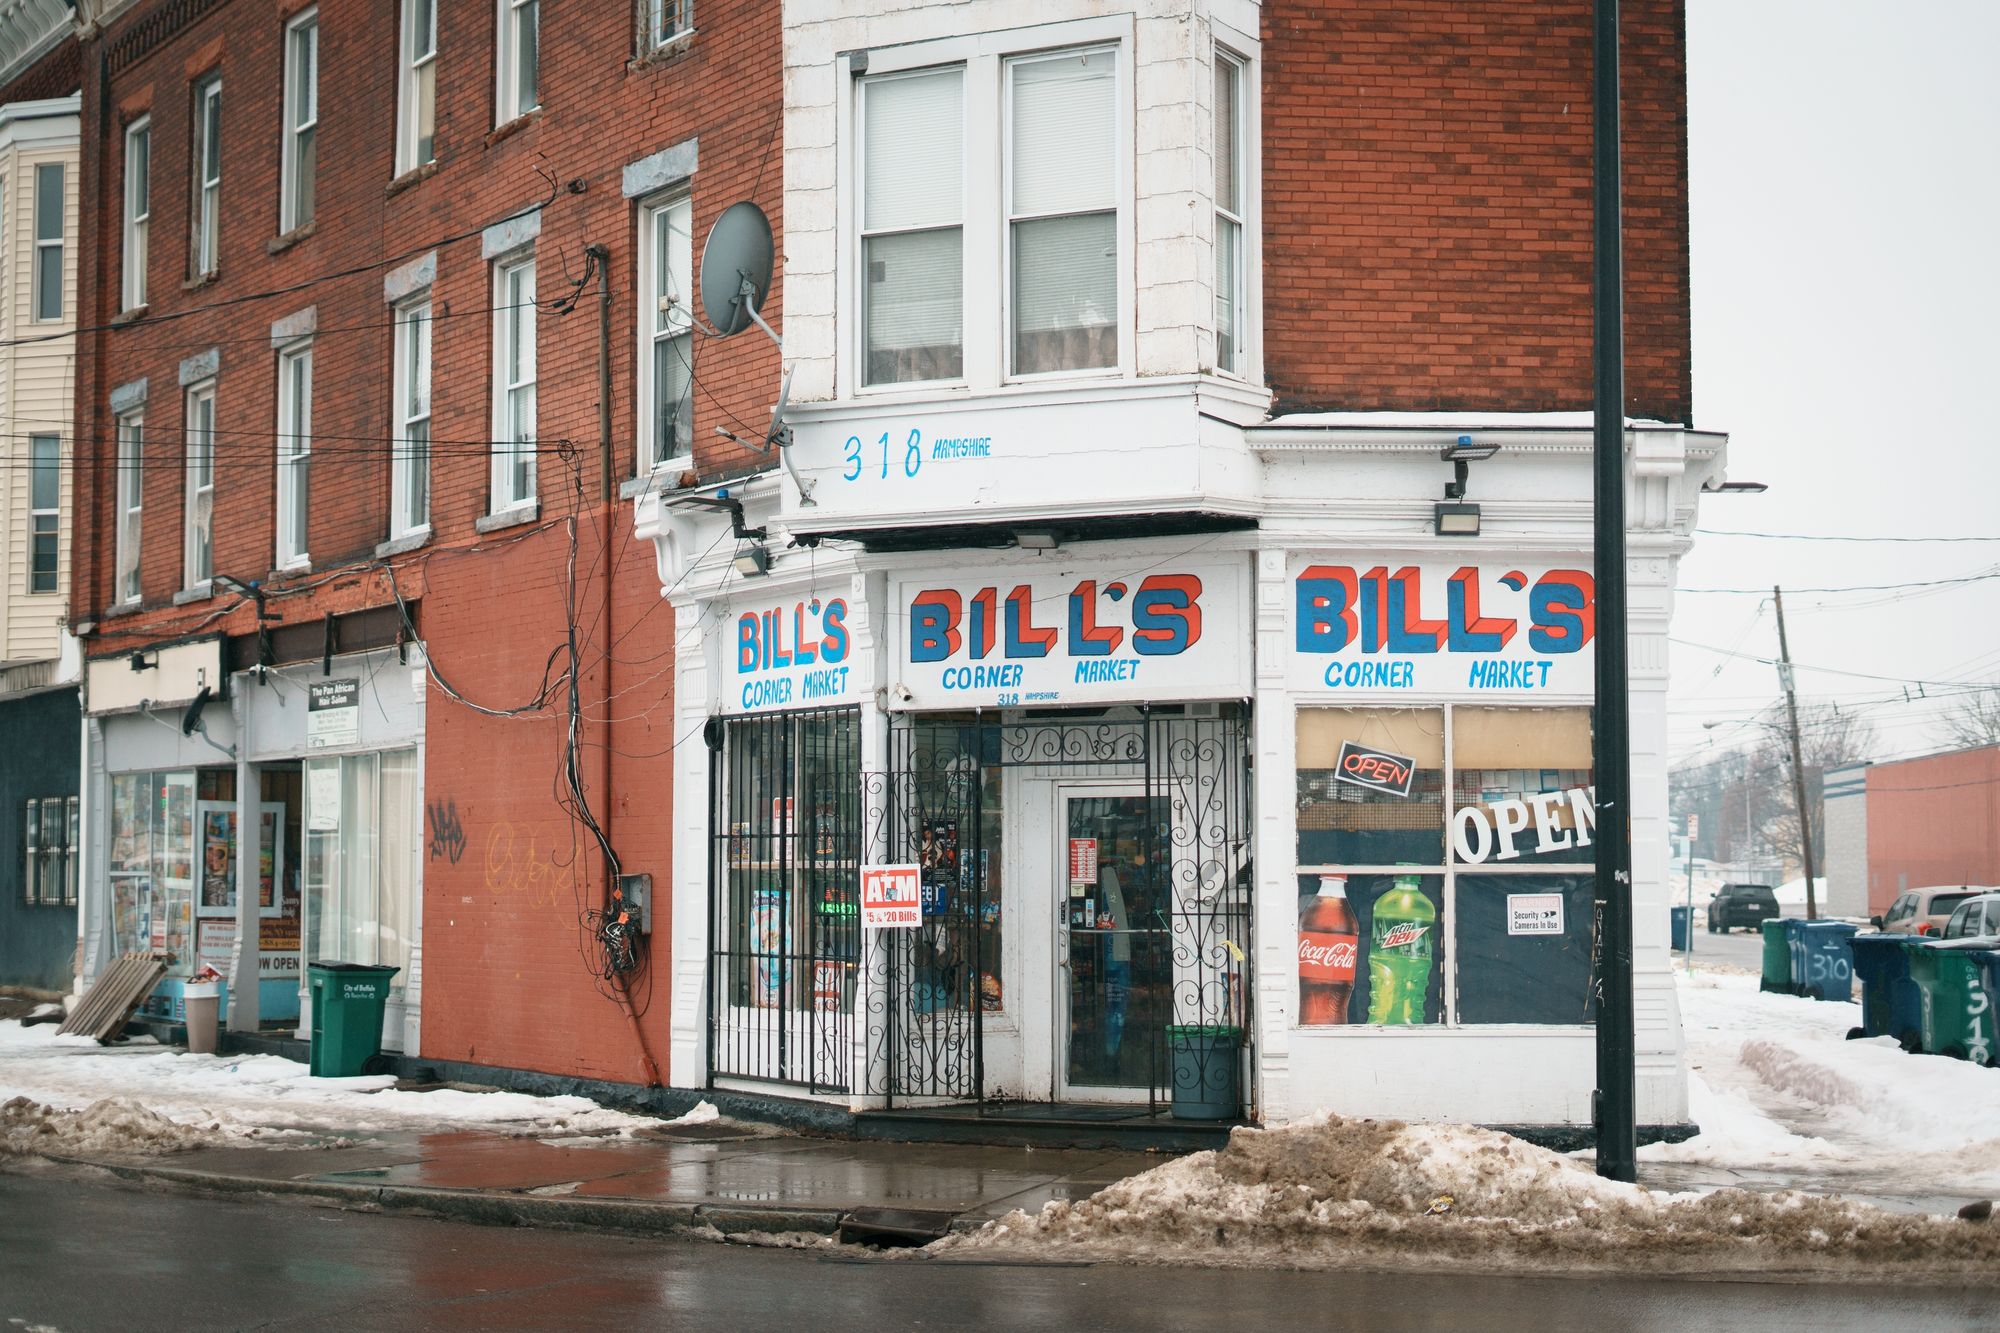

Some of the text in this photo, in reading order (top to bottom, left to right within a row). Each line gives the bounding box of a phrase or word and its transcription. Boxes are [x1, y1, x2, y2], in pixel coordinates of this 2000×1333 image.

[844, 428, 991, 482] 318 HAMPSHIRE
[911, 574, 1202, 663] BILL'S
[1296, 564, 1596, 655] BILL'S
[737, 597, 850, 674] BILL'S
[743, 666, 849, 710] CORNER MARKET
[942, 659, 1141, 690] CORNER MARKET
[1324, 658, 1553, 689] CORNER MARKET
[312, 683, 355, 696] The Pan African
[319, 695, 347, 706] Hair Salon
[997, 691, 1059, 706] 318 HAMPSHIRE
[1344, 754, 1410, 785] OPEN
[1453, 785, 1596, 864] OPEN
[866, 874, 917, 903] ATM
[866, 911, 875, 923] $5
[884, 911, 897, 922] $20
[898, 910, 917, 922] Bills
[1514, 910, 1540, 921] Security
[1514, 920, 1558, 930] Cameras In Use
[273, 957, 300, 970] OPEN
[1298, 938, 1357, 969] Coca-Cola
[1811, 953, 1850, 981] 310
[343, 984, 353, 992] City
[359, 984, 376, 992] Buffalo
